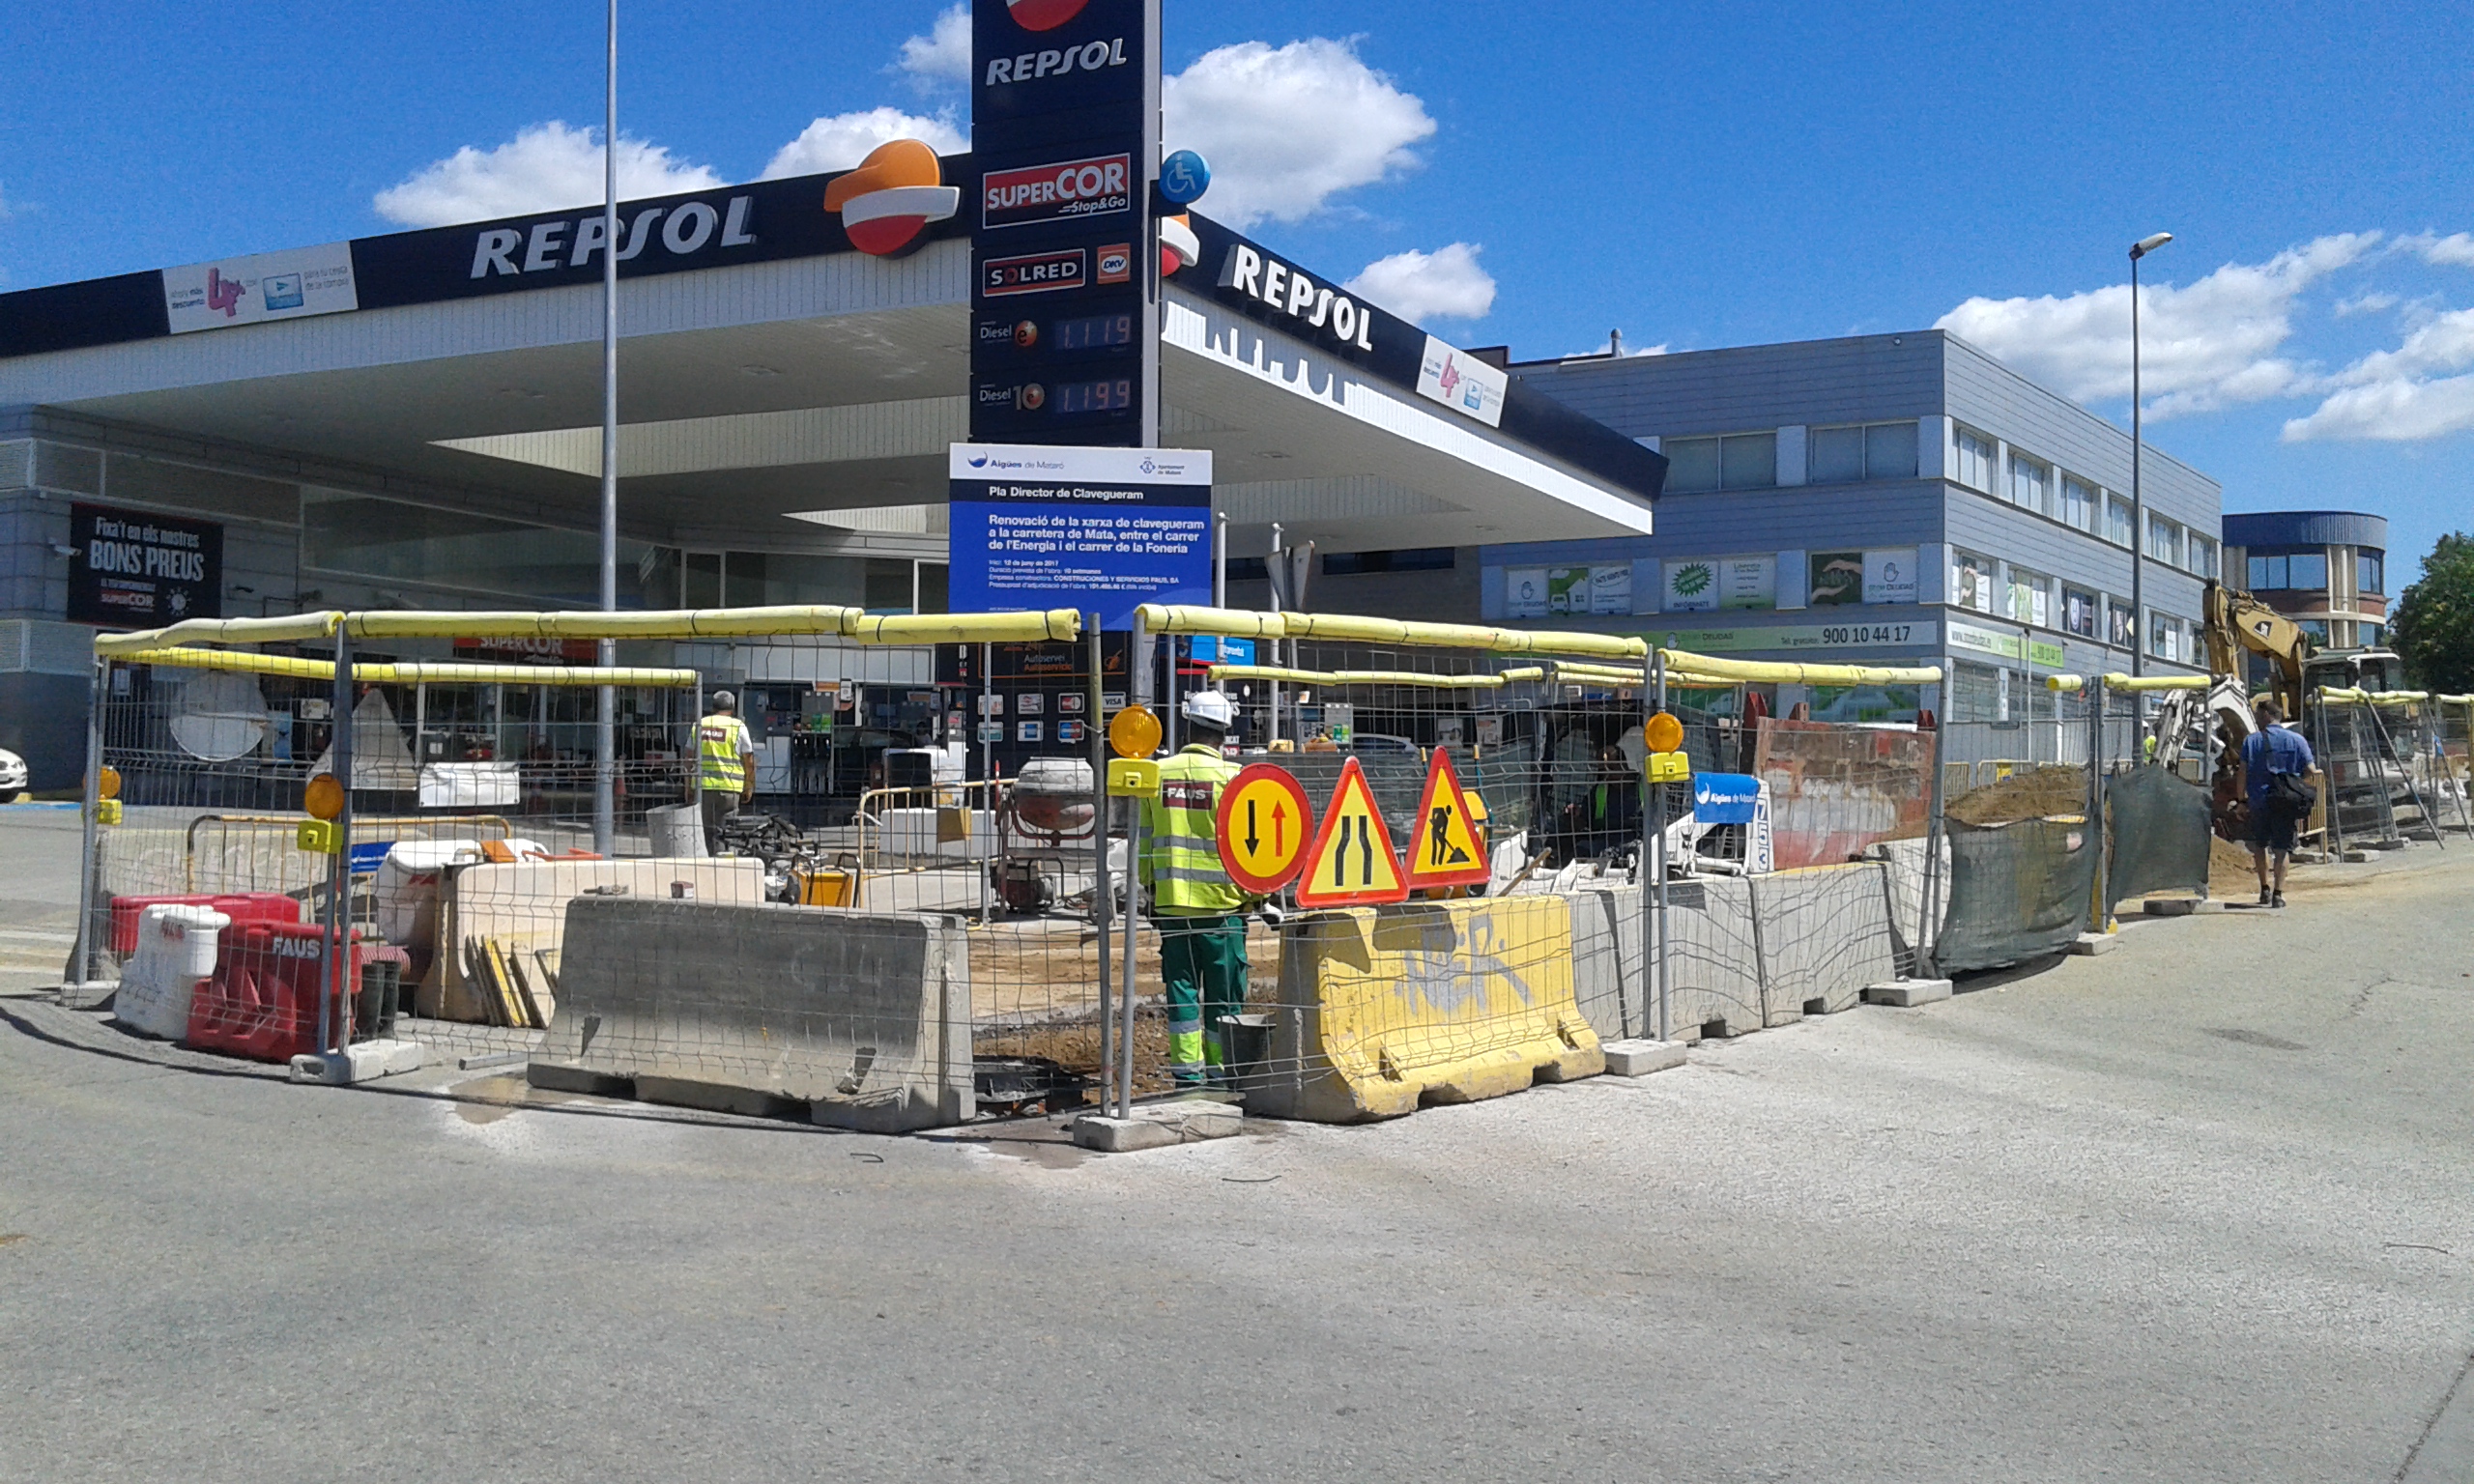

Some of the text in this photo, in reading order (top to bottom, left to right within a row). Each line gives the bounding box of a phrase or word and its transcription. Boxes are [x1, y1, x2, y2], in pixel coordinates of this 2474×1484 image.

[986, 38, 1127, 86] REPSOL
[987, 162, 1125, 210] SUPERCOR
[1070, 195, 1126, 214] Stop&Go
[470, 195, 758, 279] REPSOL
[1104, 258, 1125, 269] DKV
[991, 262, 1078, 285] SOLRED
[1231, 244, 1372, 352] REPSOL
[980, 324, 1012, 339] Diesel
[979, 387, 1012, 402] Diesel
[991, 459, 1022, 470] Aigües
[1036, 461, 1065, 470] Mataró
[989, 486, 1144, 500] Pla Director de Clavegueram
[989, 514, 1205, 530] Renovació de la xarxa de clavegueram
[96, 515, 200, 549] Fixa't en els nostres
[989, 527, 1200, 542] a la carretera de Mata, entre el carrer
[988, 539, 1004, 550] de
[1006, 539, 1056, 553] l'Energia
[1058, 540, 1063, 551] i
[1065, 541, 1077, 552] el
[1079, 542, 1113, 553] carrer
[1115, 542, 1131, 553] de
[1133, 542, 1143, 553] la
[90, 538, 205, 582] BONS PREUS
[1823, 628, 1849, 643] 900
[1853, 627, 1869, 643] 10
[1872, 626, 1889, 642] 44
[1894, 625, 1911, 642] 17
[480, 636, 563, 654] SUPERCOR
[1105, 698, 1122, 706] VISA
[1166, 786, 1206, 801] FAUS
[1711, 793, 1732, 805] Aigües
[1732, 793, 1740, 803] de
[272, 937, 322, 959] FAUS
